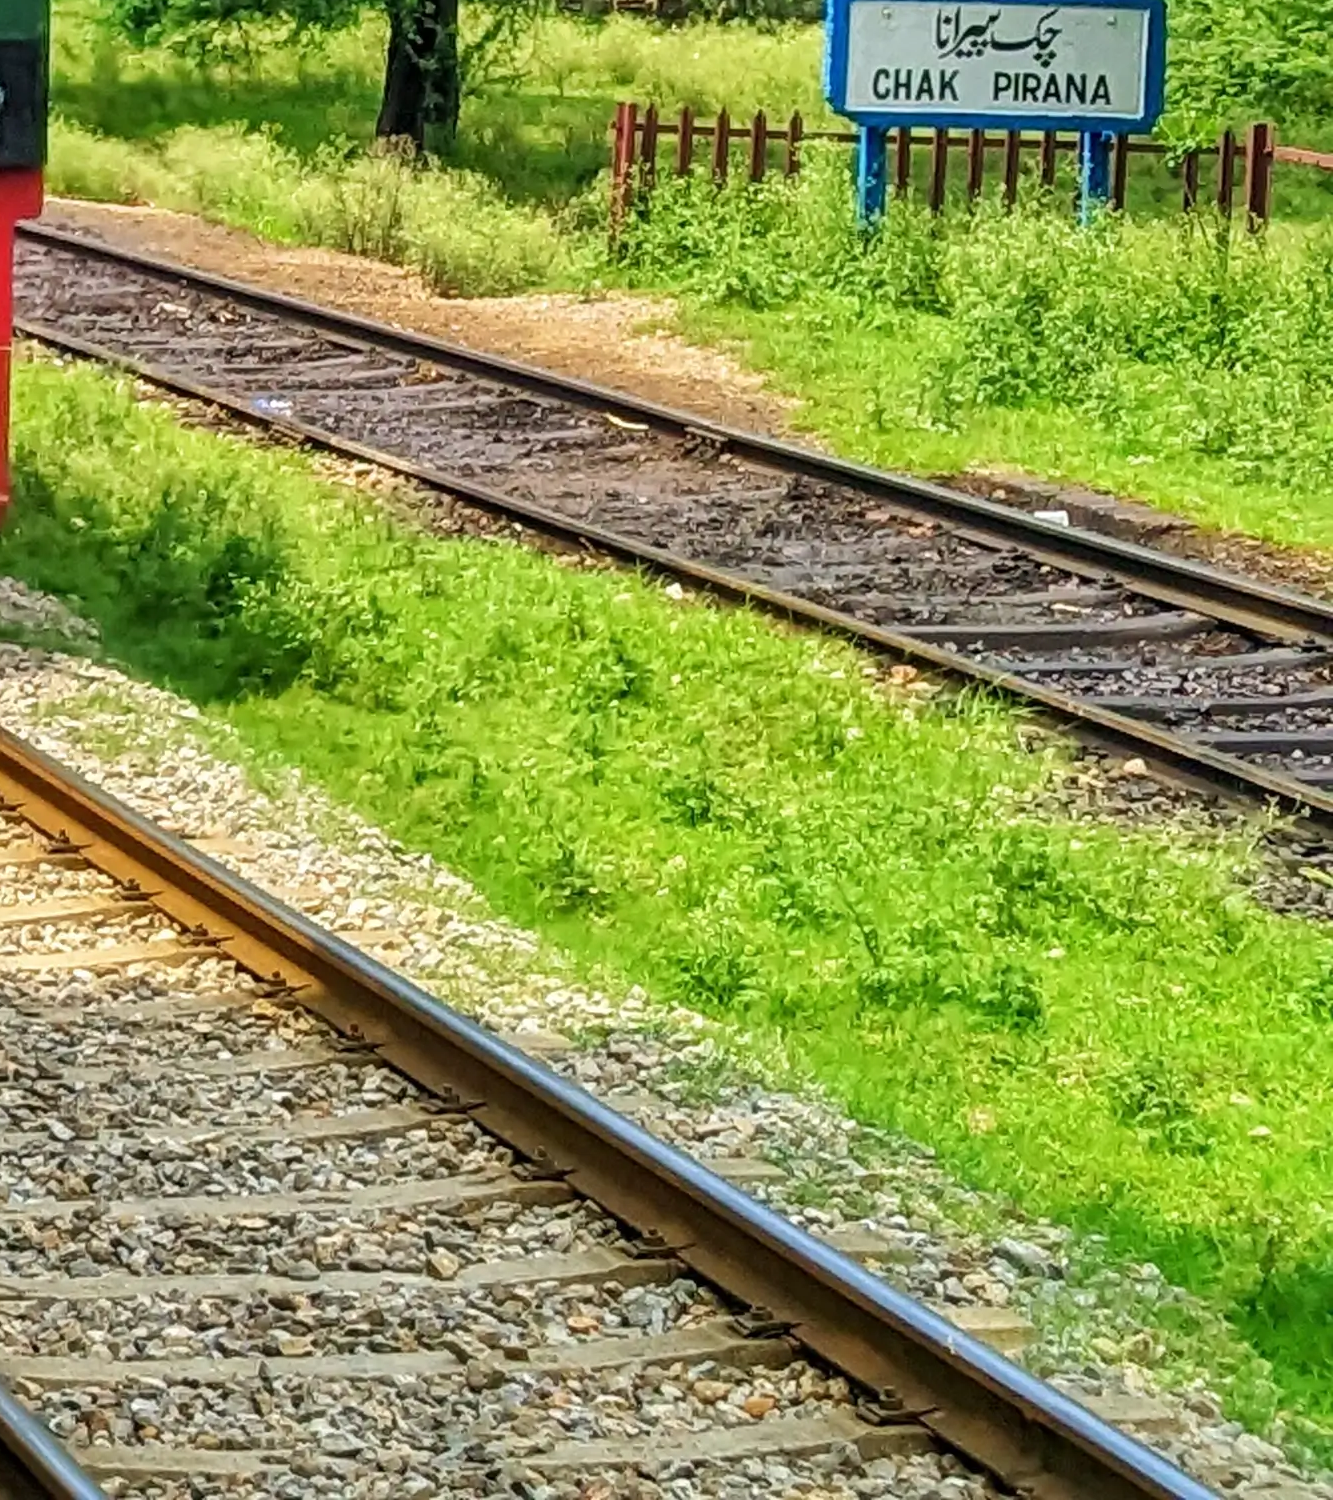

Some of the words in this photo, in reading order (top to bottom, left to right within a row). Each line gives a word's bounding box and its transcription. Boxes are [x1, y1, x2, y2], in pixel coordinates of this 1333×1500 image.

[990, 6, 1063, 68] چک
[872, 68, 960, 102] CHAK
[993, 71, 1112, 105] PIRANA
